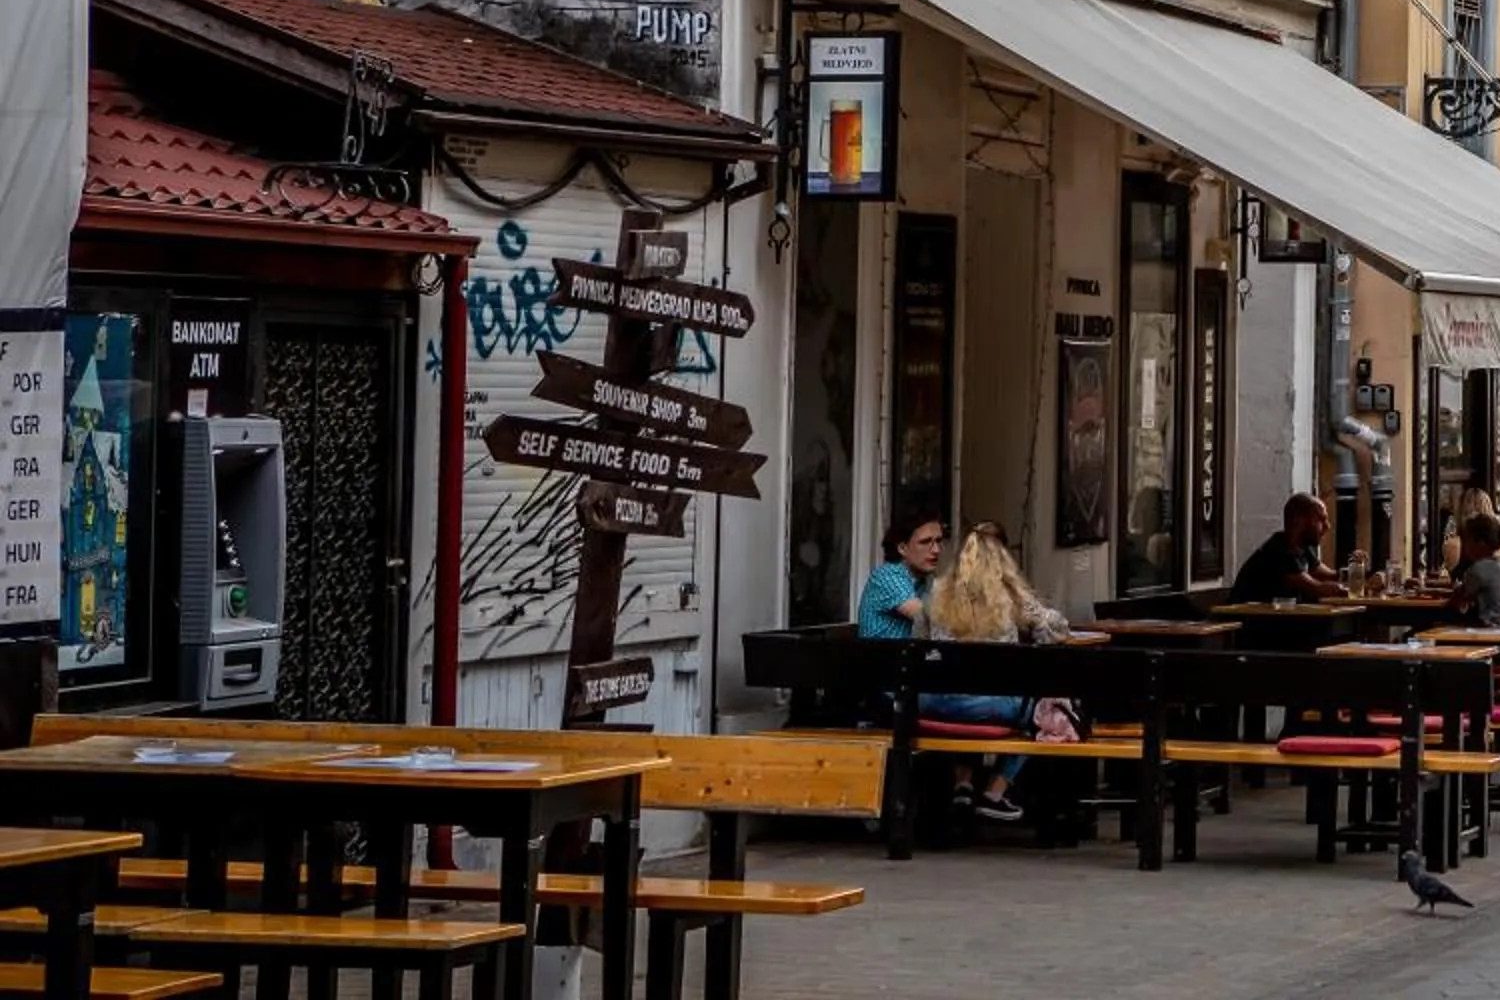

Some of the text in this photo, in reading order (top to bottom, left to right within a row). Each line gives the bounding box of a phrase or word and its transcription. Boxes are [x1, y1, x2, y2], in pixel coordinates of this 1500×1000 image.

[636, 5, 711, 45] PUMP
[619, 285, 691, 319] MEDVEDGRAD
[172, 320, 240, 344] BANKOMAT
[189, 353, 220, 379] ATM
[593, 380, 649, 416] SOUVENIR
[651, 396, 683, 423] SHOP
[10, 415, 40, 435] GER
[518, 430, 558, 458] SELF
[562, 438, 624, 469] SERVICE
[630, 451, 671, 476] FOOD
[13, 457, 40, 478] FRA
[7, 500, 41, 521] GER
[5, 542, 41, 564] HUN
[5, 585, 38, 607] FRA
